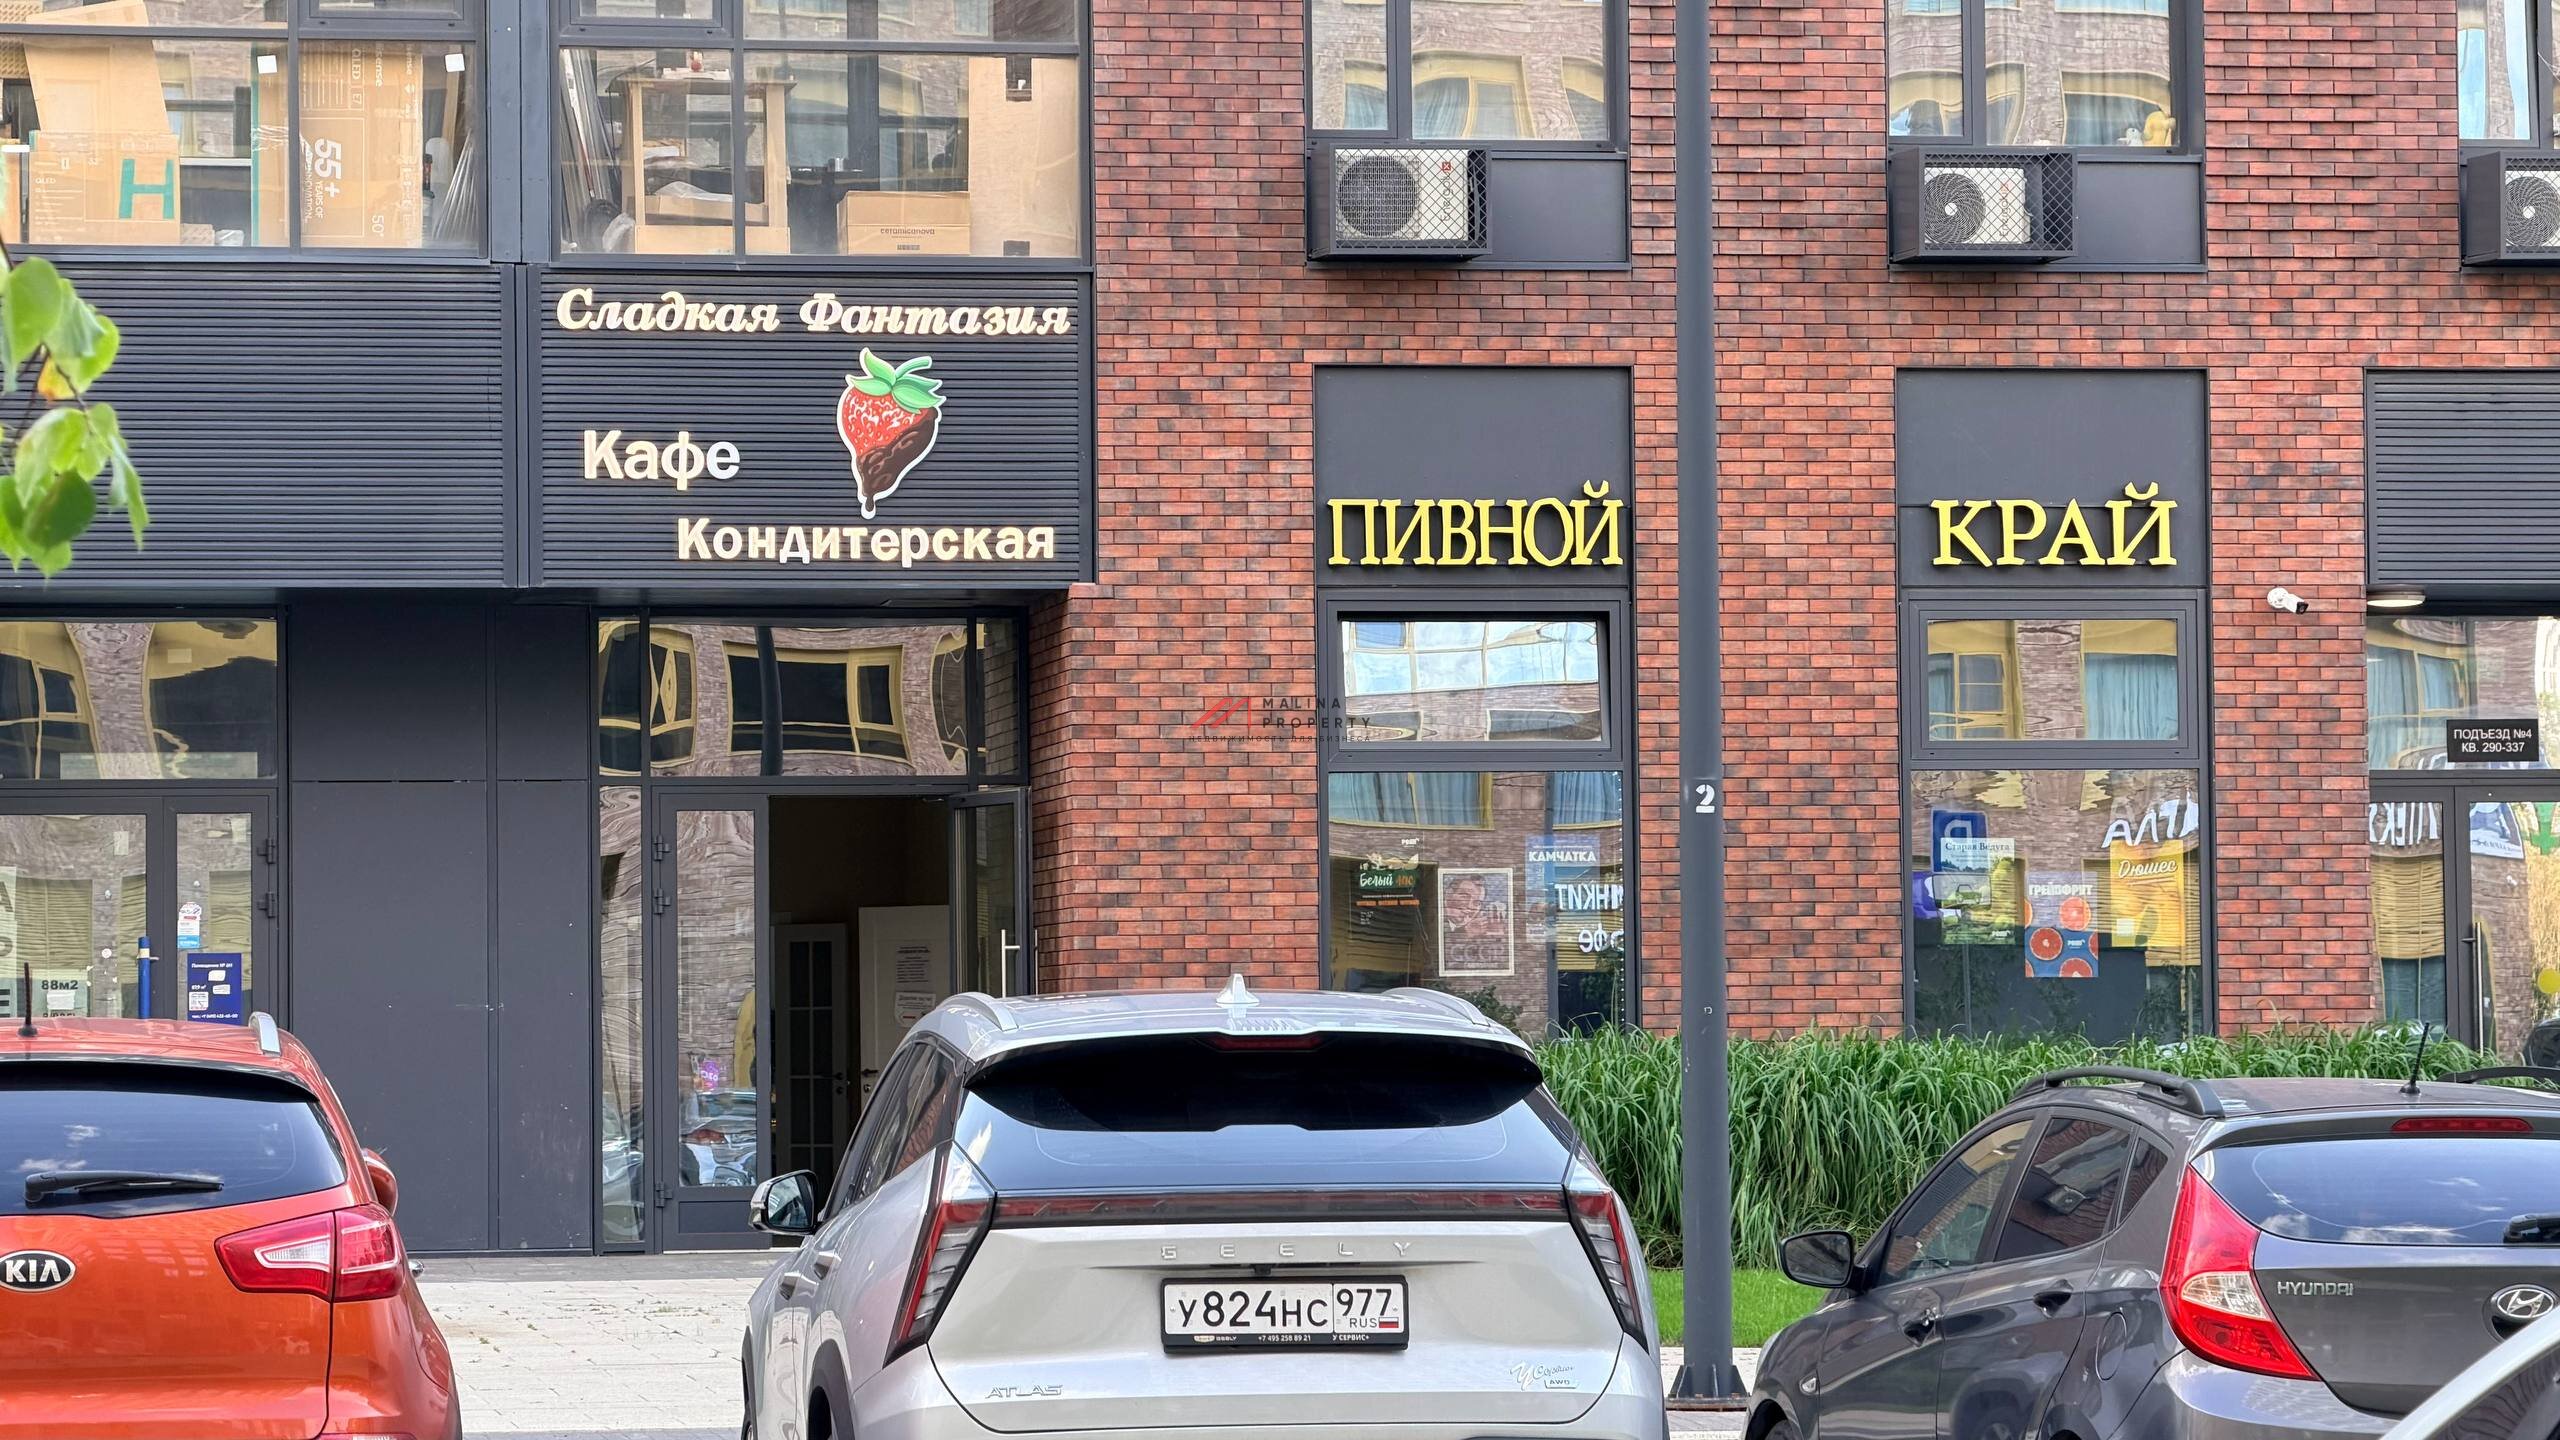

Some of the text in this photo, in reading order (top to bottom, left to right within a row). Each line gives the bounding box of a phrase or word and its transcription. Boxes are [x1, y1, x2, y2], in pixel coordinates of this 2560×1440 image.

[315, 181, 323, 218] YEARS OF
[556, 287, 1071, 336] Сладкая Фантазия
[584, 429, 741, 491] Кафе
[1326, 479, 1624, 567] ПИВНОЙ
[1930, 481, 2178, 567] КРАЙ
[677, 517, 1055, 568] Кондитерская
[2453, 728, 2532, 741] ПОДЪЕЗД №4
[2461, 742, 2525, 752] КВ. 290-337
[1695, 784, 1715, 814] 2
[1528, 851, 1597, 861] КАМЧАТКА
[2119, 860, 2177, 878] Дюшес
[1360, 873, 1393, 887] Белый
[1161, 1241, 1411, 1260] GEELY
[5, 1259, 61, 1283] KIA
[2277, 1281, 2354, 1296] HYUNDAI
[1336, 1288, 1392, 1317] 977
[1350, 1317, 1378, 1328] RUS
[984, 1384, 1064, 1399] ATLAS
